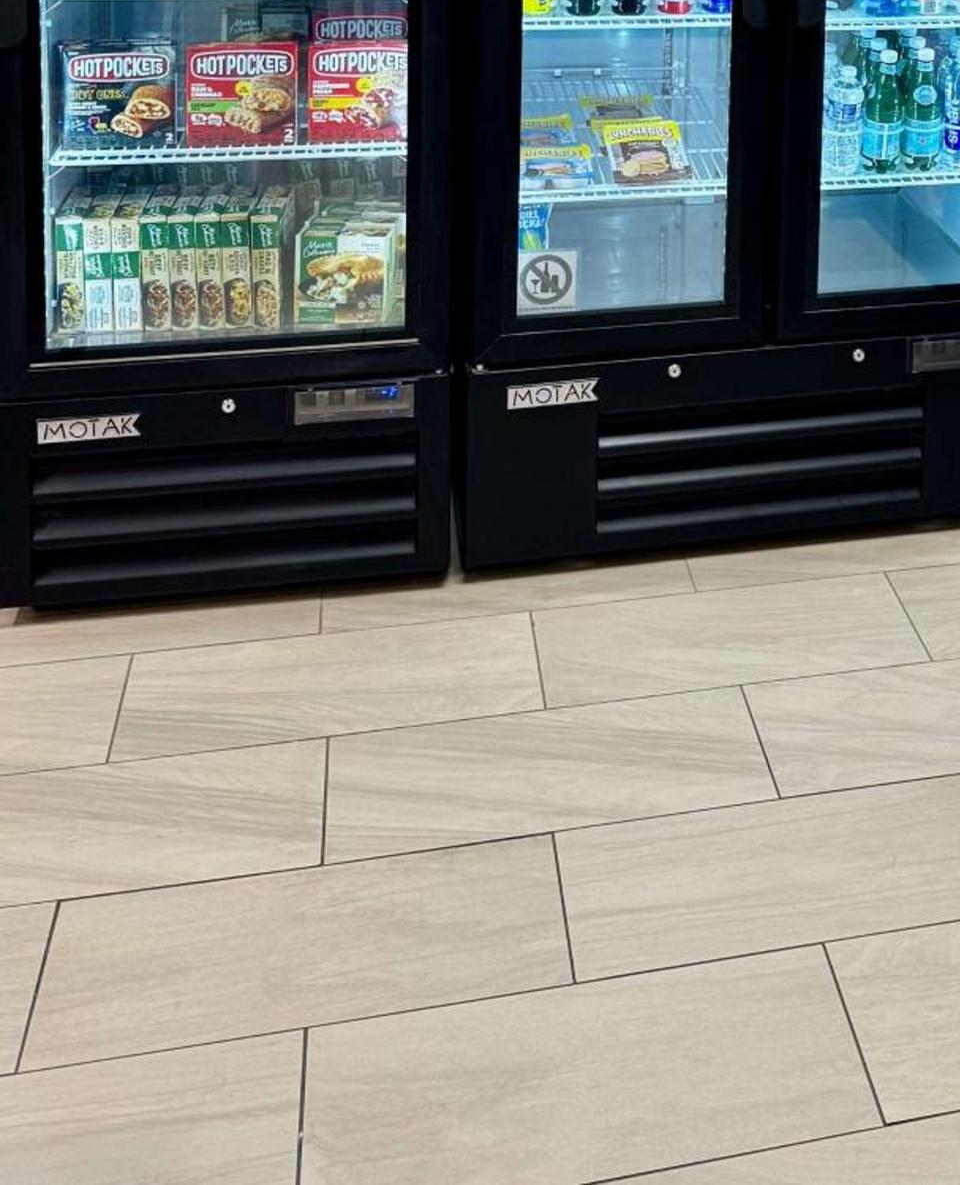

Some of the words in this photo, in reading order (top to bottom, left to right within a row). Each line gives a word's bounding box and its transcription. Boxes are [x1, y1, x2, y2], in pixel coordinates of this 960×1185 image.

[321, 21, 348, 39] HOT
[349, 19, 402, 37] POCKETS
[74, 59, 104, 78] HOT
[104, 57, 164, 77] POCKETS
[197, 56, 227, 75] HOT
[227, 55, 288, 74] POCKETS
[319, 54, 348, 72] HOT
[348, 52, 408, 72] POCKETS
[512, 382, 592, 407] MOTAK
[43, 417, 133, 441] MOTAK
